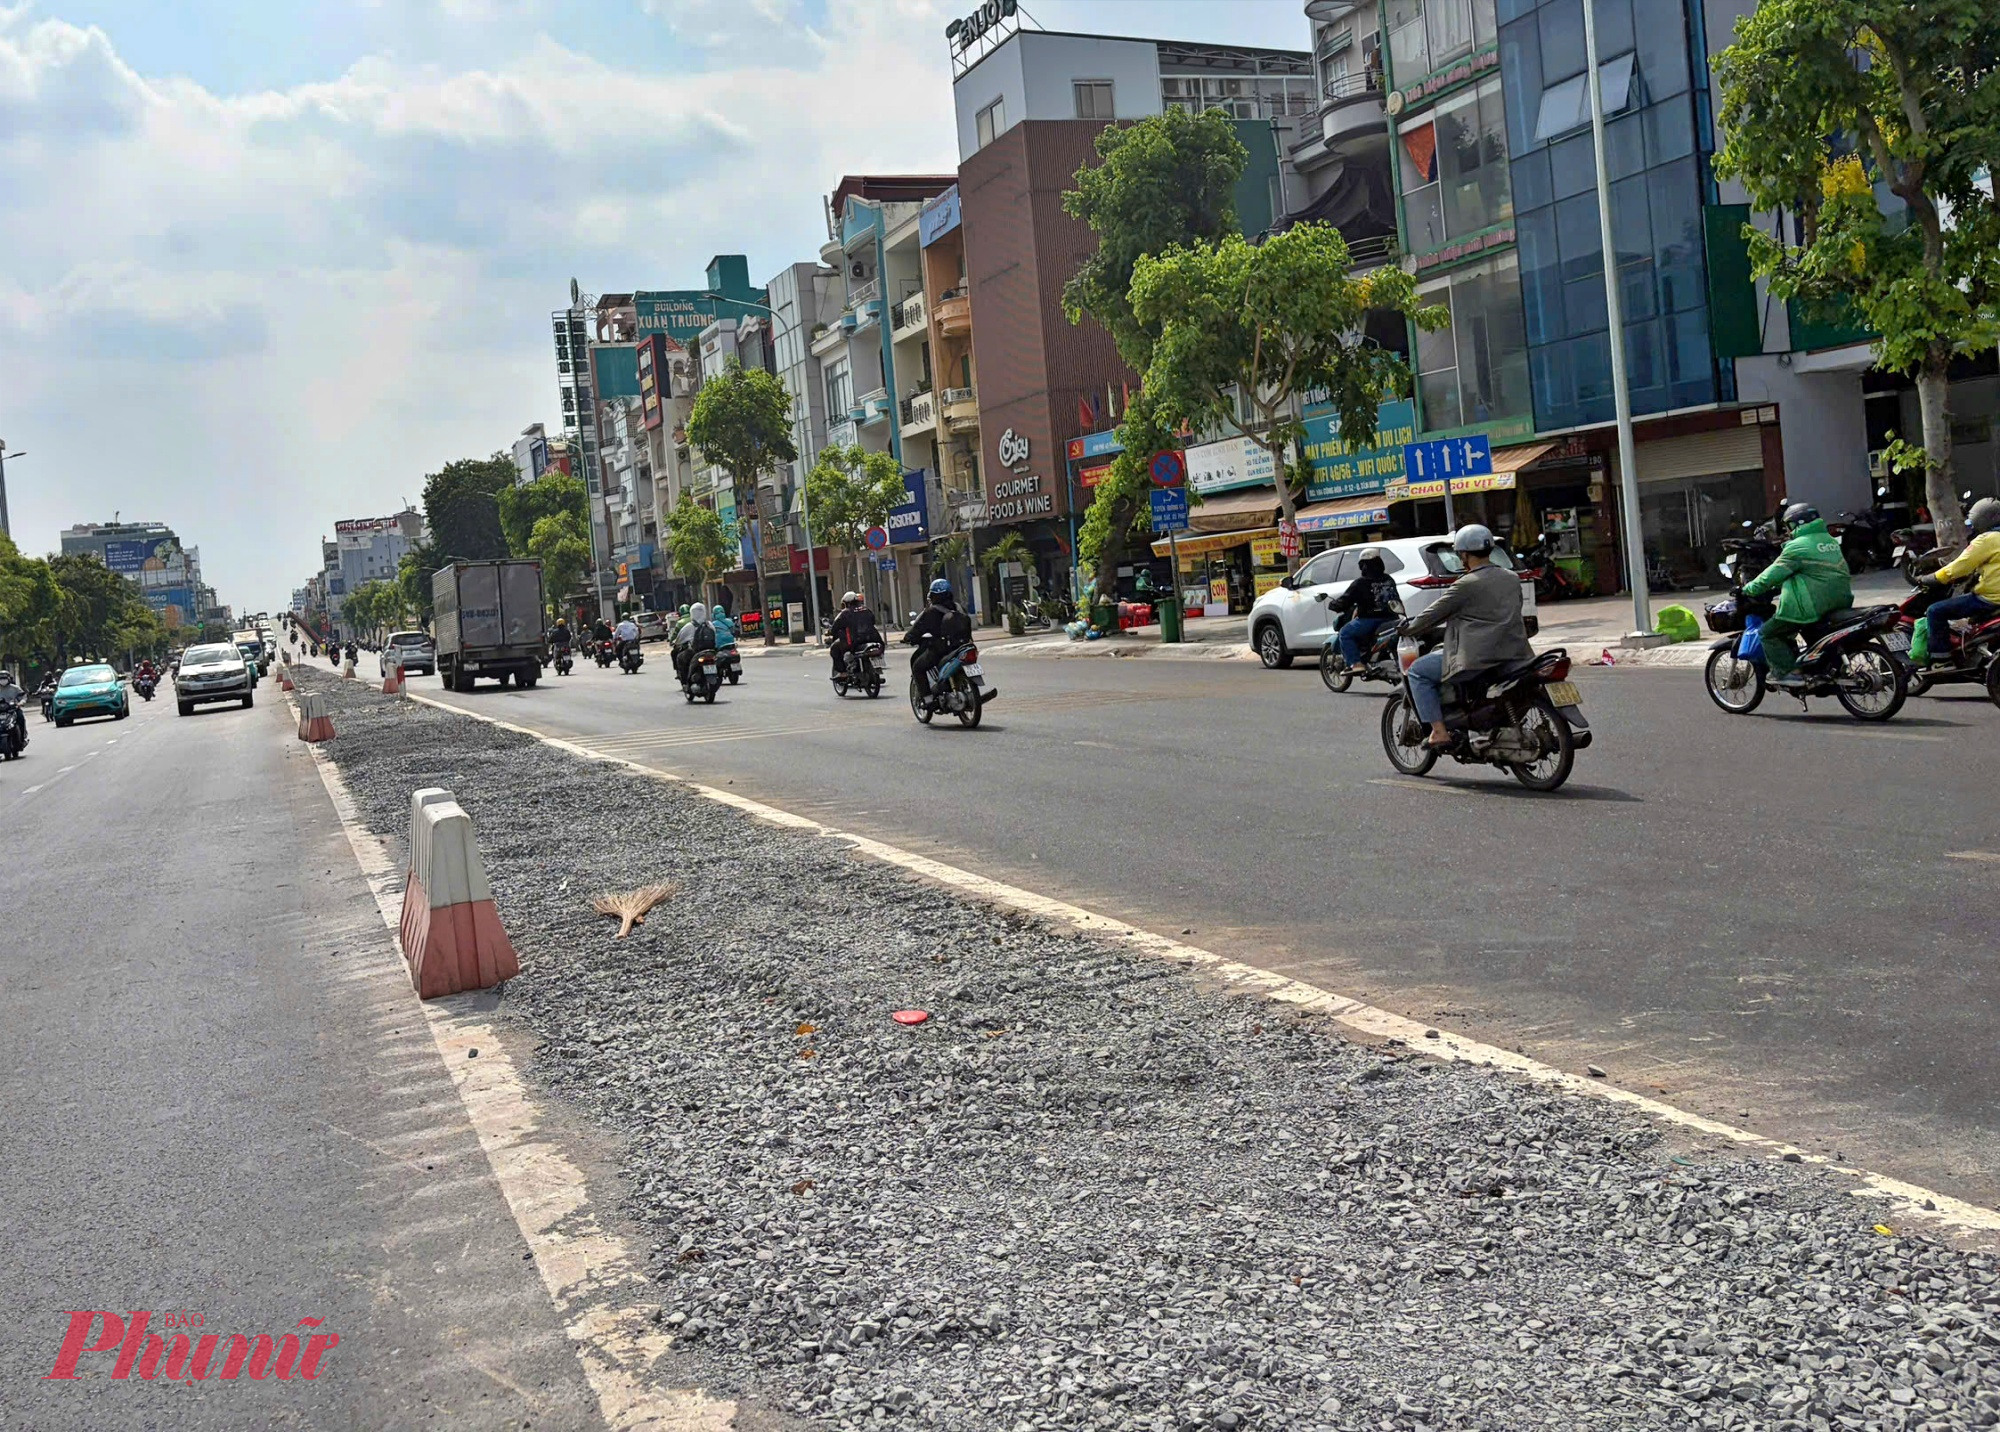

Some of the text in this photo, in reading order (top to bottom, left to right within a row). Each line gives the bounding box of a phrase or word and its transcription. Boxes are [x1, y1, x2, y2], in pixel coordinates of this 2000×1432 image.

[654, 302, 694, 312] BUILDING
[999, 428, 1028, 467] Enjoy
[1383, 429, 1394, 448] DU
[1394, 426, 1413, 447] LỊCH
[1357, 459, 1375, 476] WIFI
[995, 476, 1040, 498] GOURMET
[990, 495, 1050, 519] FOOD & WINE
